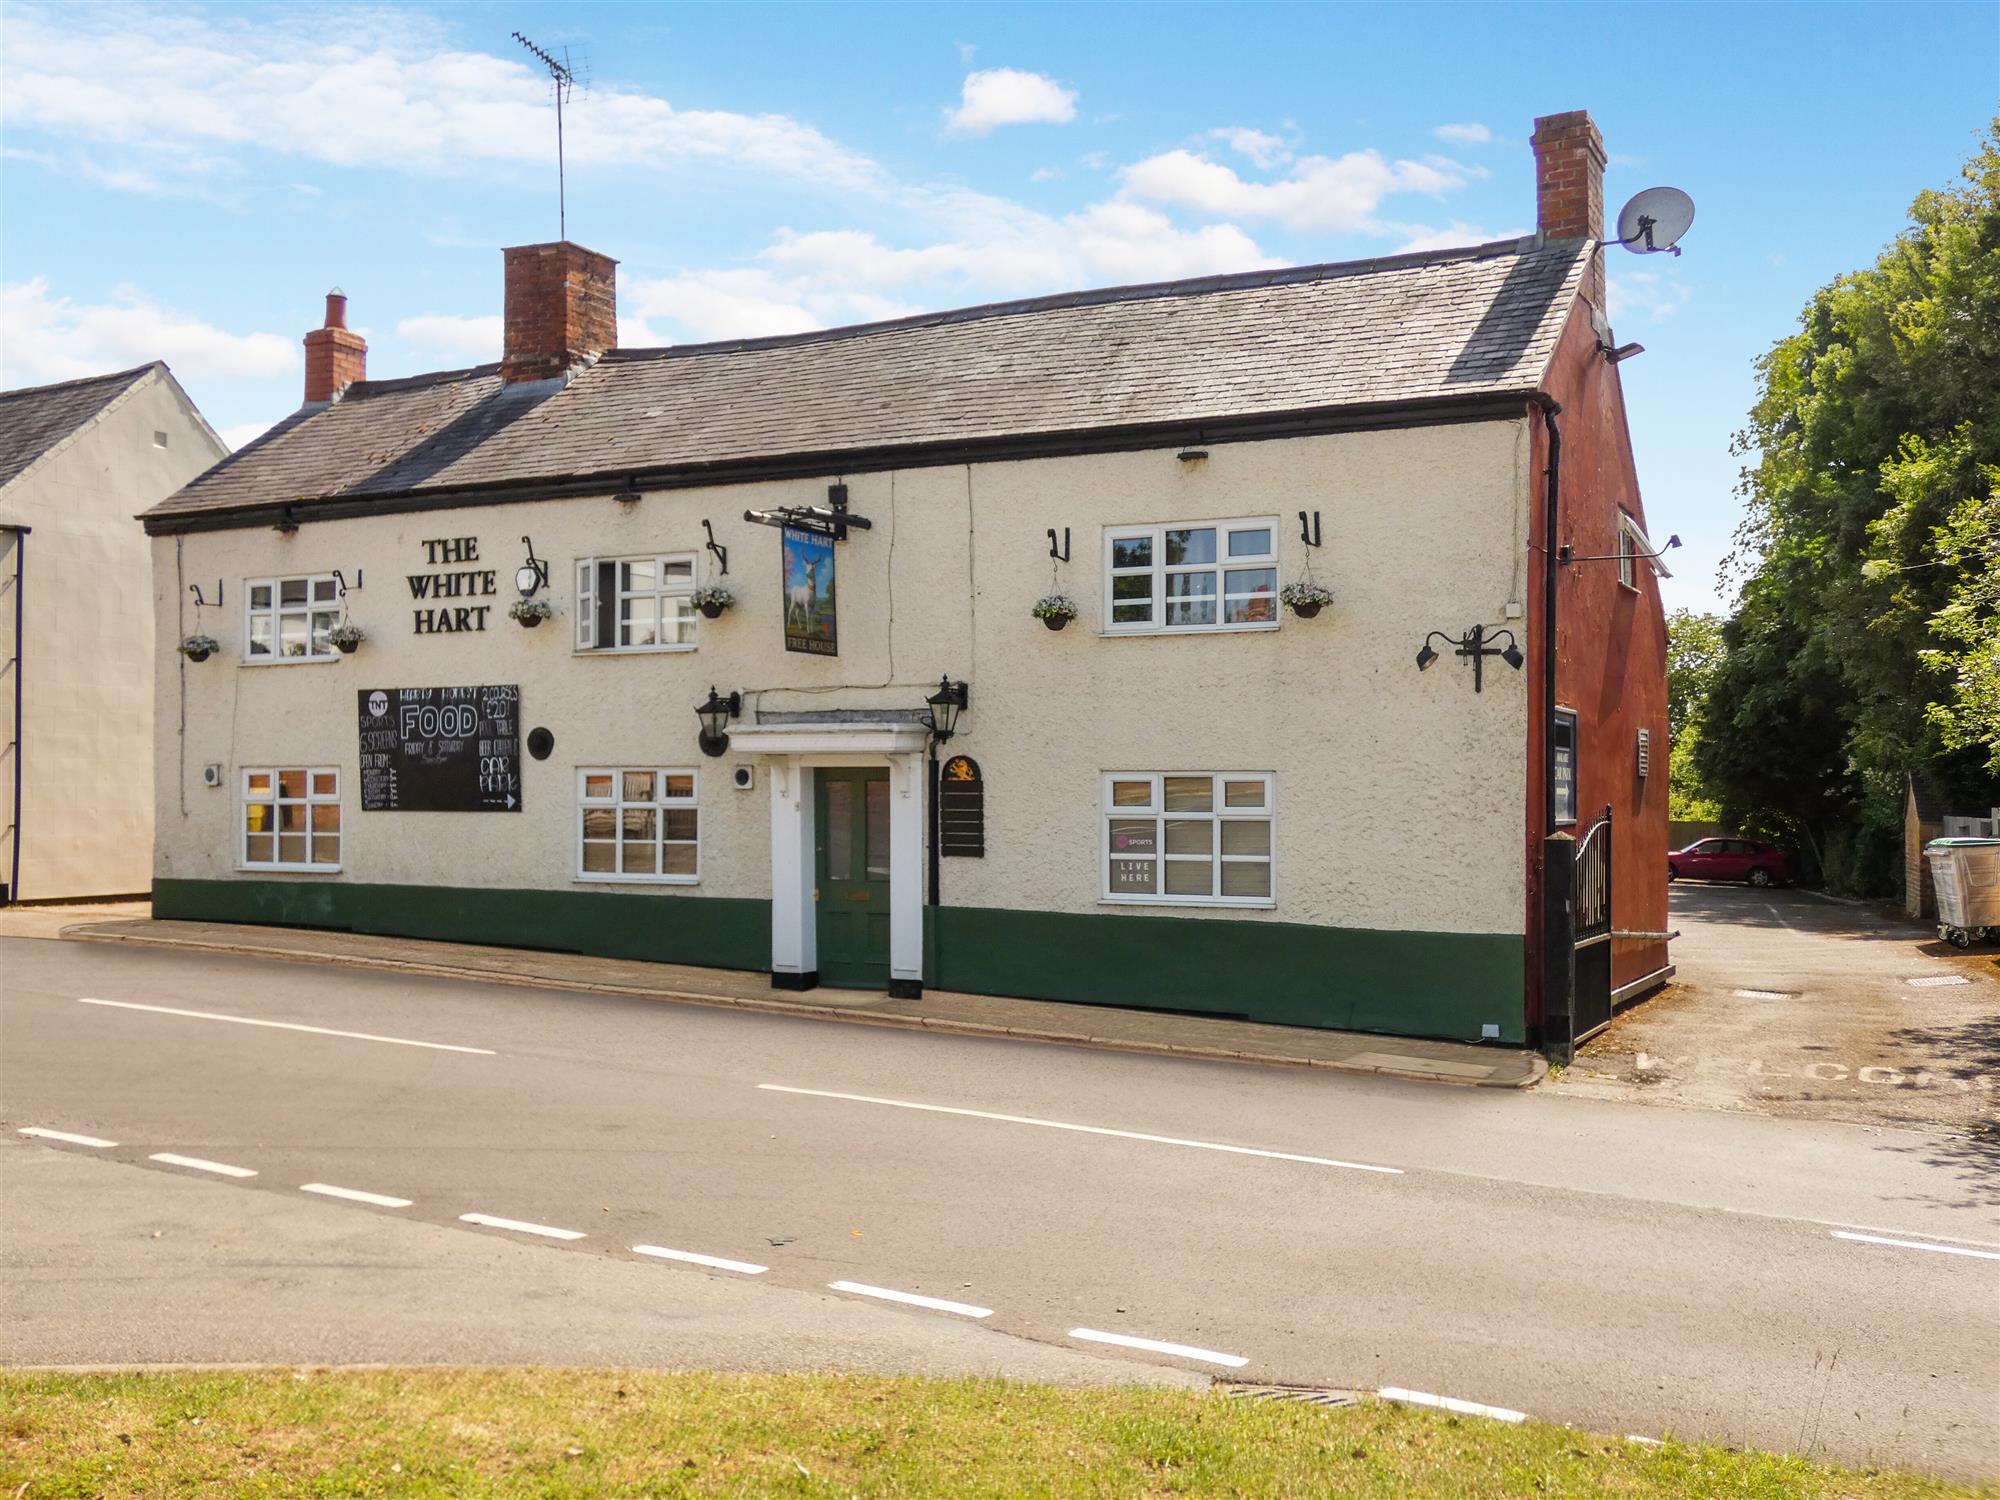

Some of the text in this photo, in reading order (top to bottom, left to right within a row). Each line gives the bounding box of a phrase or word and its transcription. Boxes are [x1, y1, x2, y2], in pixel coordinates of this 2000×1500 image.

[785, 527, 833, 548] WHITE HART
[422, 537, 479, 564] THE
[406, 570, 496, 599] WHITE
[413, 605, 490, 634] HART
[787, 639, 836, 654] FREE HOUSE
[369, 700, 387, 710] TNT
[400, 704, 478, 740] FOOD
[480, 756, 509, 775] CAR
[479, 773, 518, 793] PARK
[1120, 862, 1149, 871] LIVE
[1120, 873, 1149, 882] HERE
